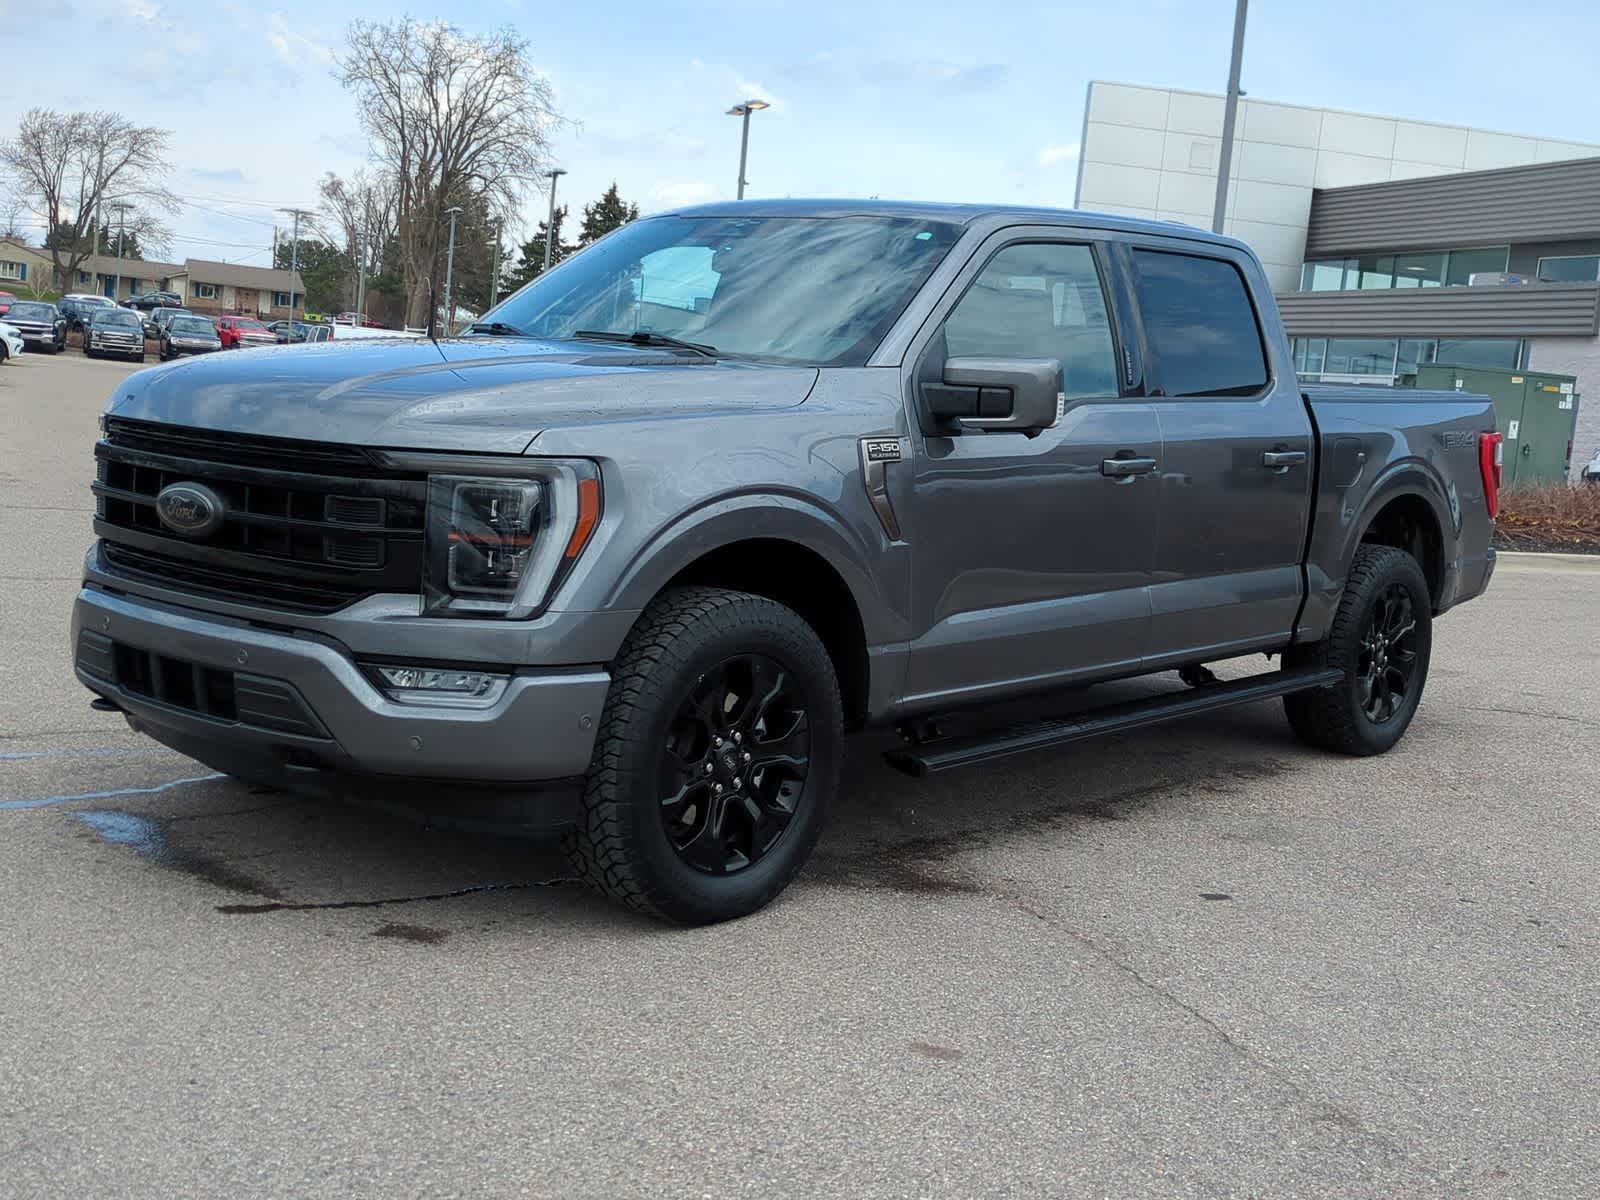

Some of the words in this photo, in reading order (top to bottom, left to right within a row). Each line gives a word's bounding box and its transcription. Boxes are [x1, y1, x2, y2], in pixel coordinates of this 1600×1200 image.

[868, 443, 900, 452] F-150
[1441, 431, 1474, 450] FX4
[166, 495, 198, 520] Ford
